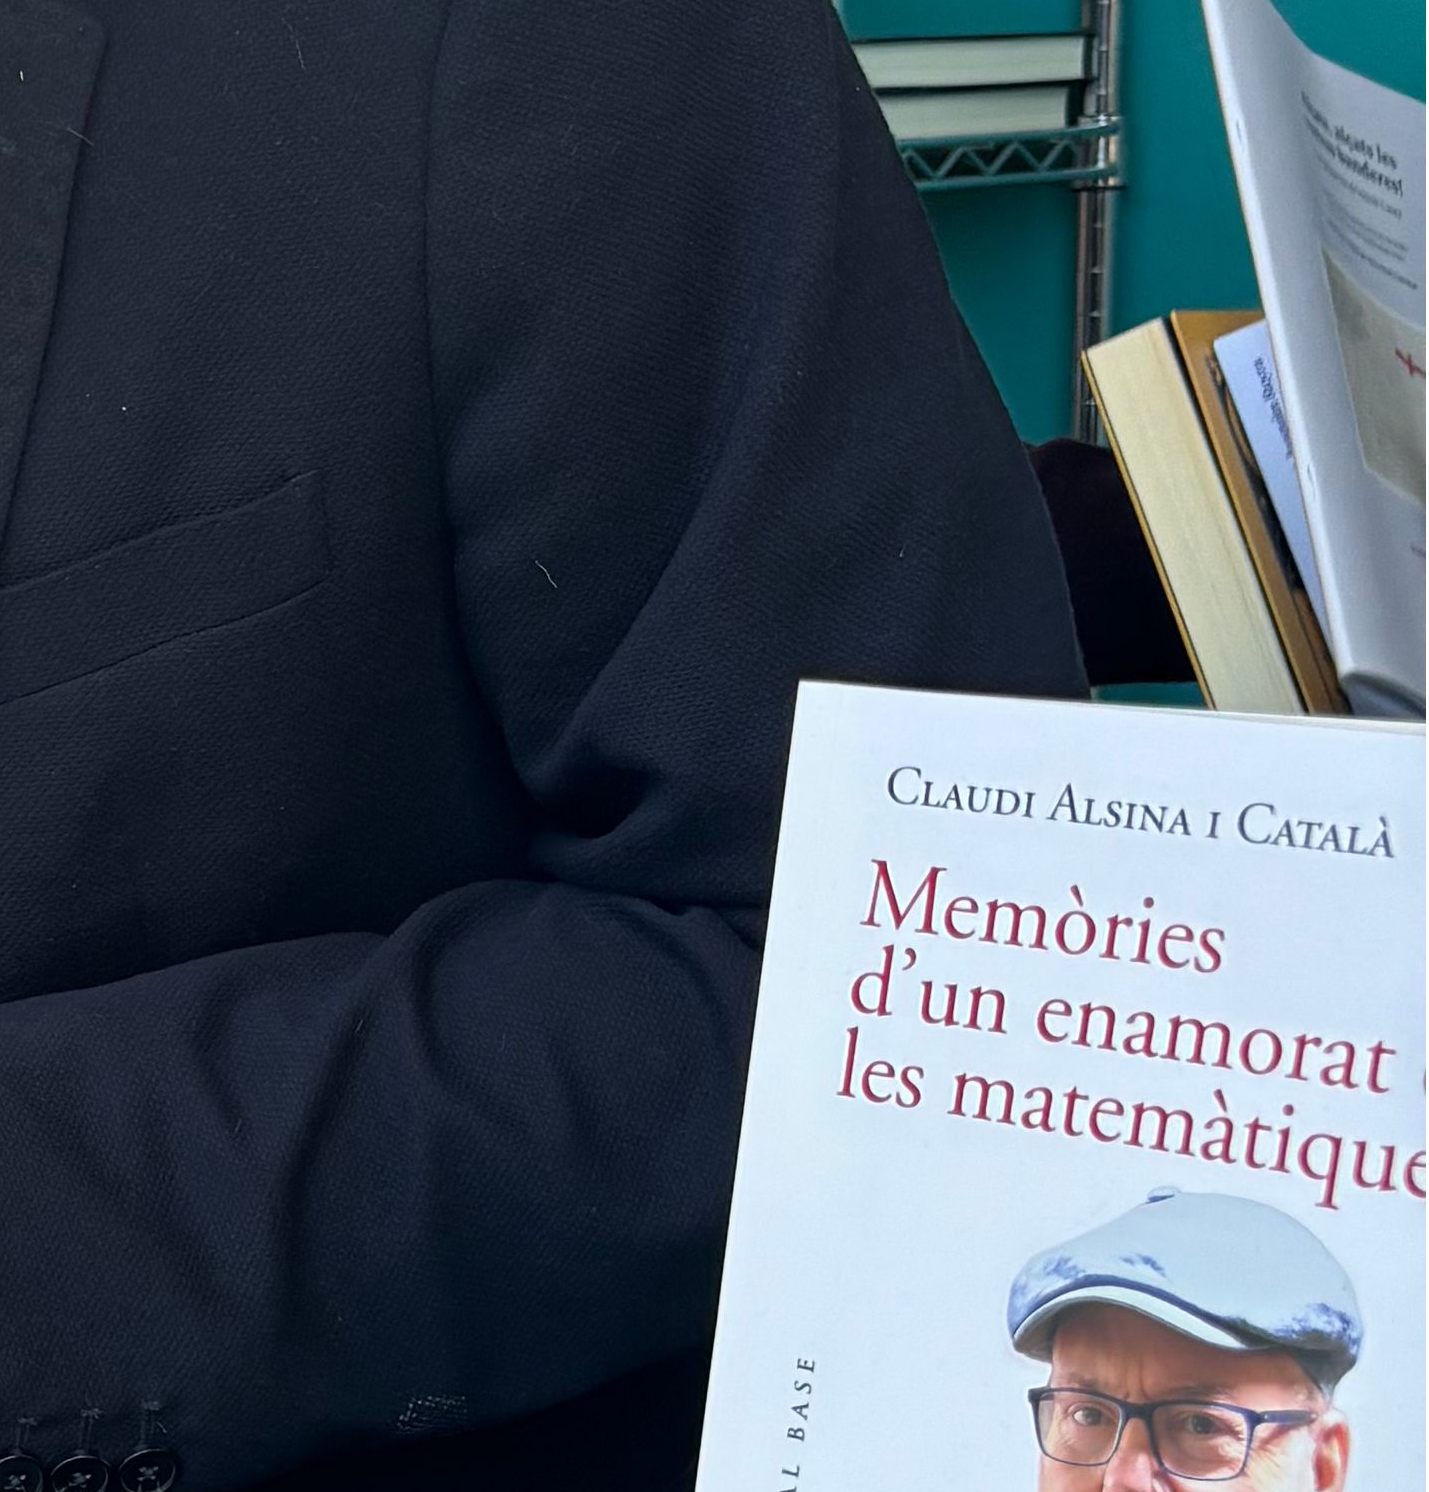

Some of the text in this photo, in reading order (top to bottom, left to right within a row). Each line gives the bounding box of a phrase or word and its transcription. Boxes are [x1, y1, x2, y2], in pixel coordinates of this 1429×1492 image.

[860, 859, 1227, 974] Memòries
[836, 1027, 926, 1110] les
[850, 944, 1008, 1036] d'un
[1036, 995, 1398, 1095] enamorat
[785, 1357, 816, 1443] BASE
